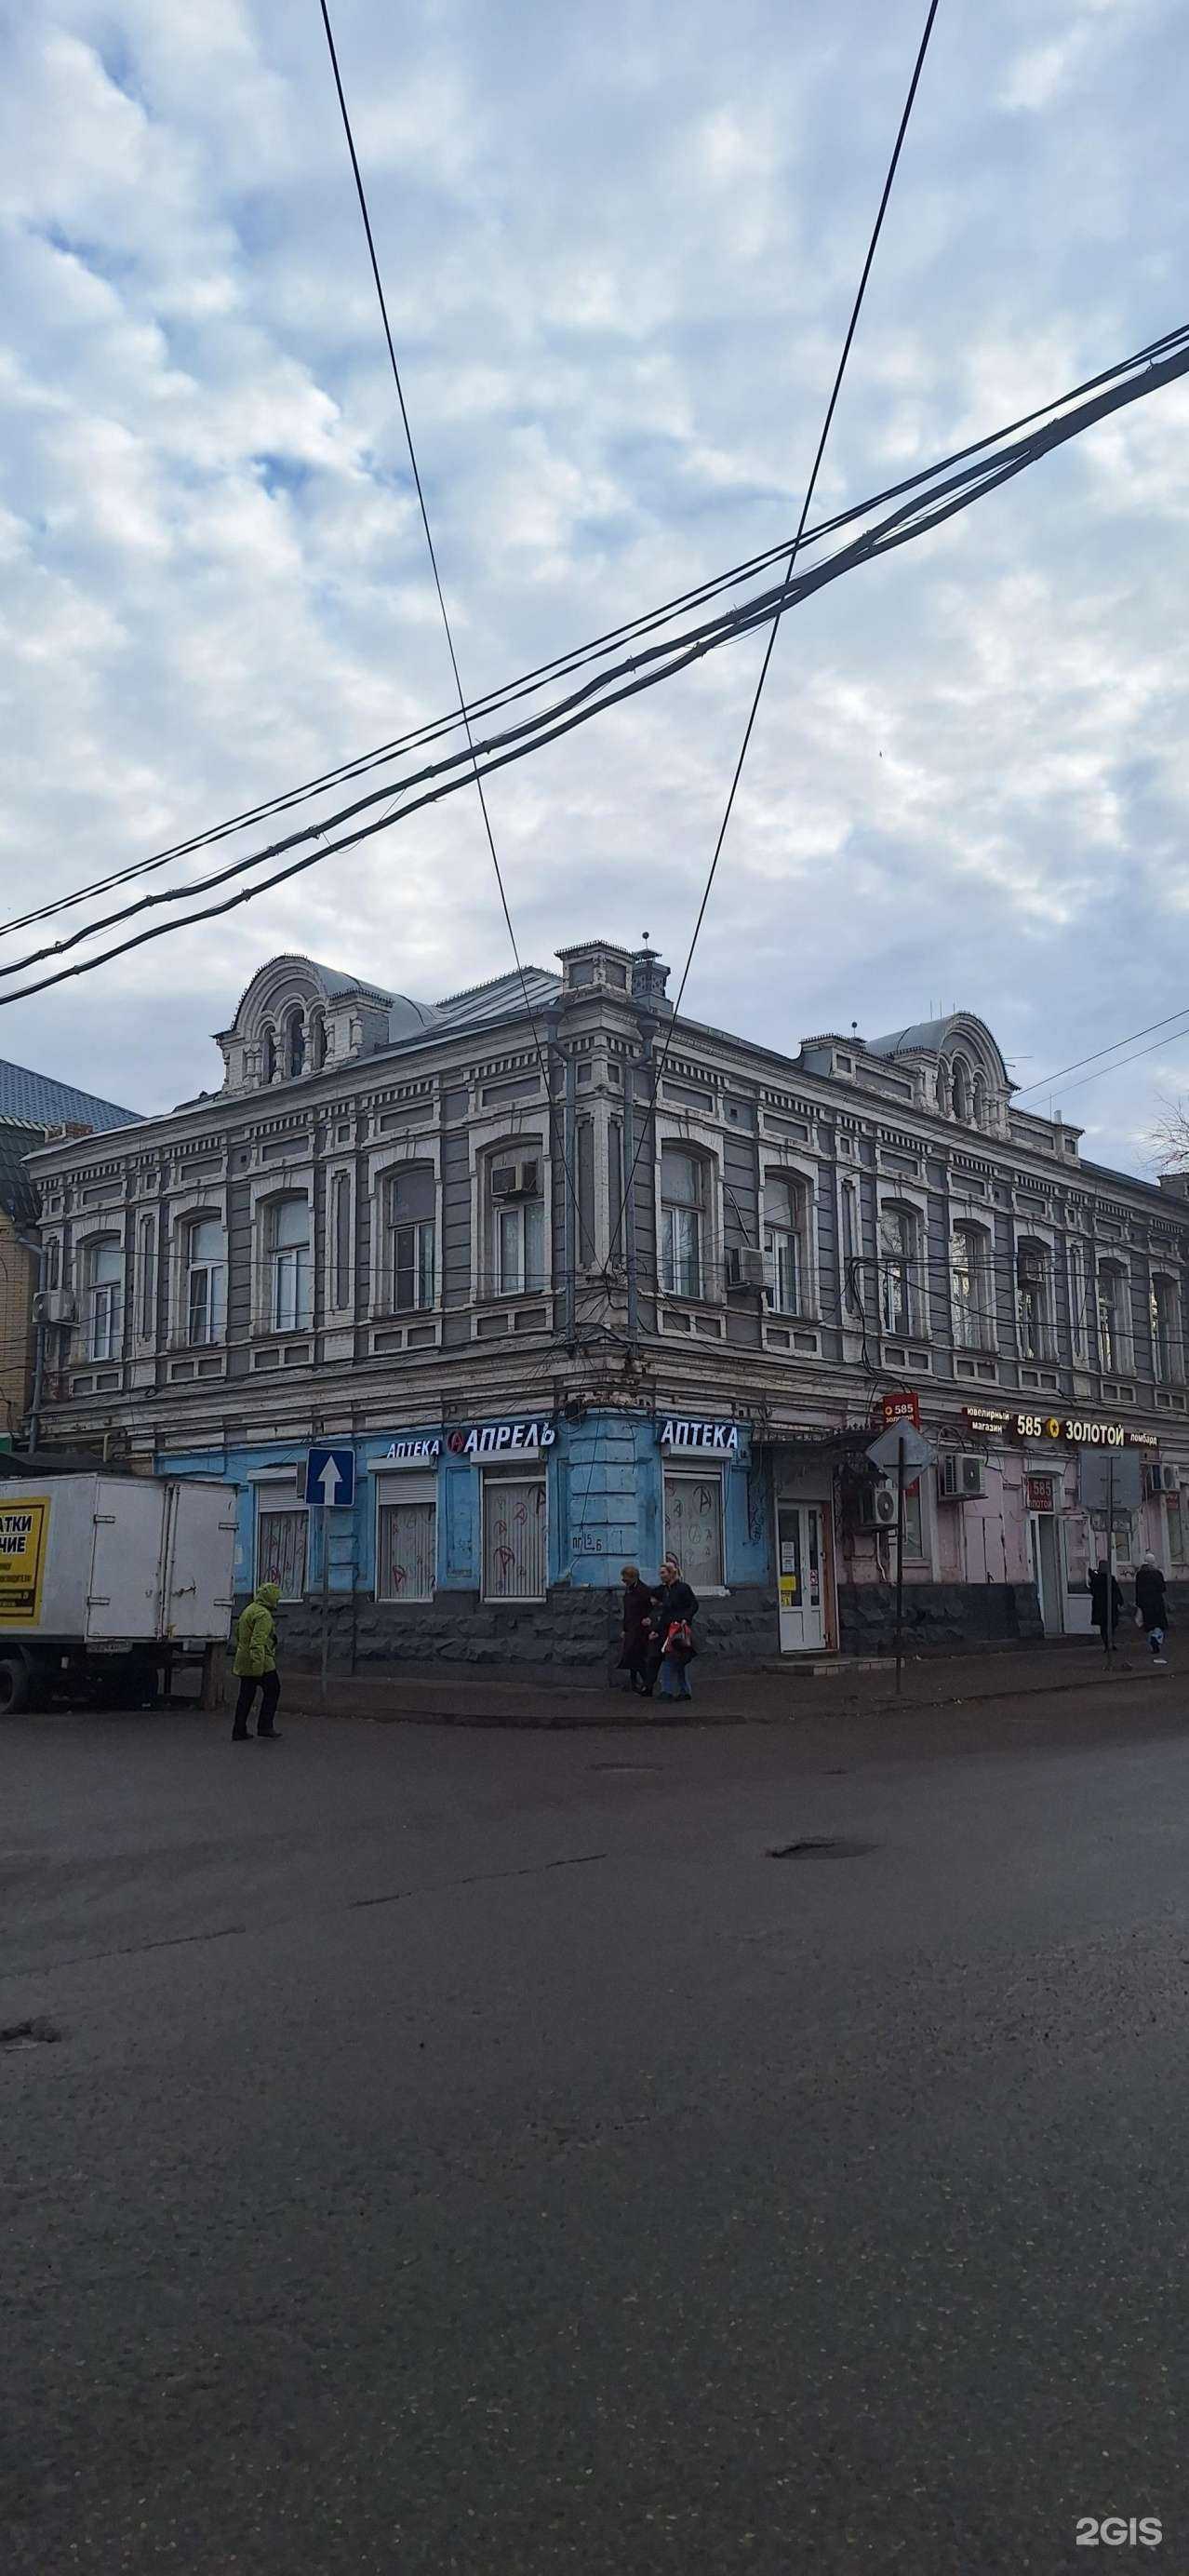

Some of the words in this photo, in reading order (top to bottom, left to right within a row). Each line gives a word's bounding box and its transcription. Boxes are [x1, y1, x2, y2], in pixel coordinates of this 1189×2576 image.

[894, 1403, 914, 1415] 585
[967, 1406, 1010, 1421] ювелирный
[971, 1421, 1003, 1432] магазин
[1016, 1414, 1042, 1437] 585
[1065, 1420, 1125, 1446] ЗОЛОТОЙ
[1129, 1433, 1157, 1445] ломбард
[387, 1440, 440, 1459] АПТЕКА
[463, 1422, 555, 1453] АПРЕЛЬ
[661, 1420, 739, 1449] АПТЕКА
[1033, 1481, 1051, 1496] 585
